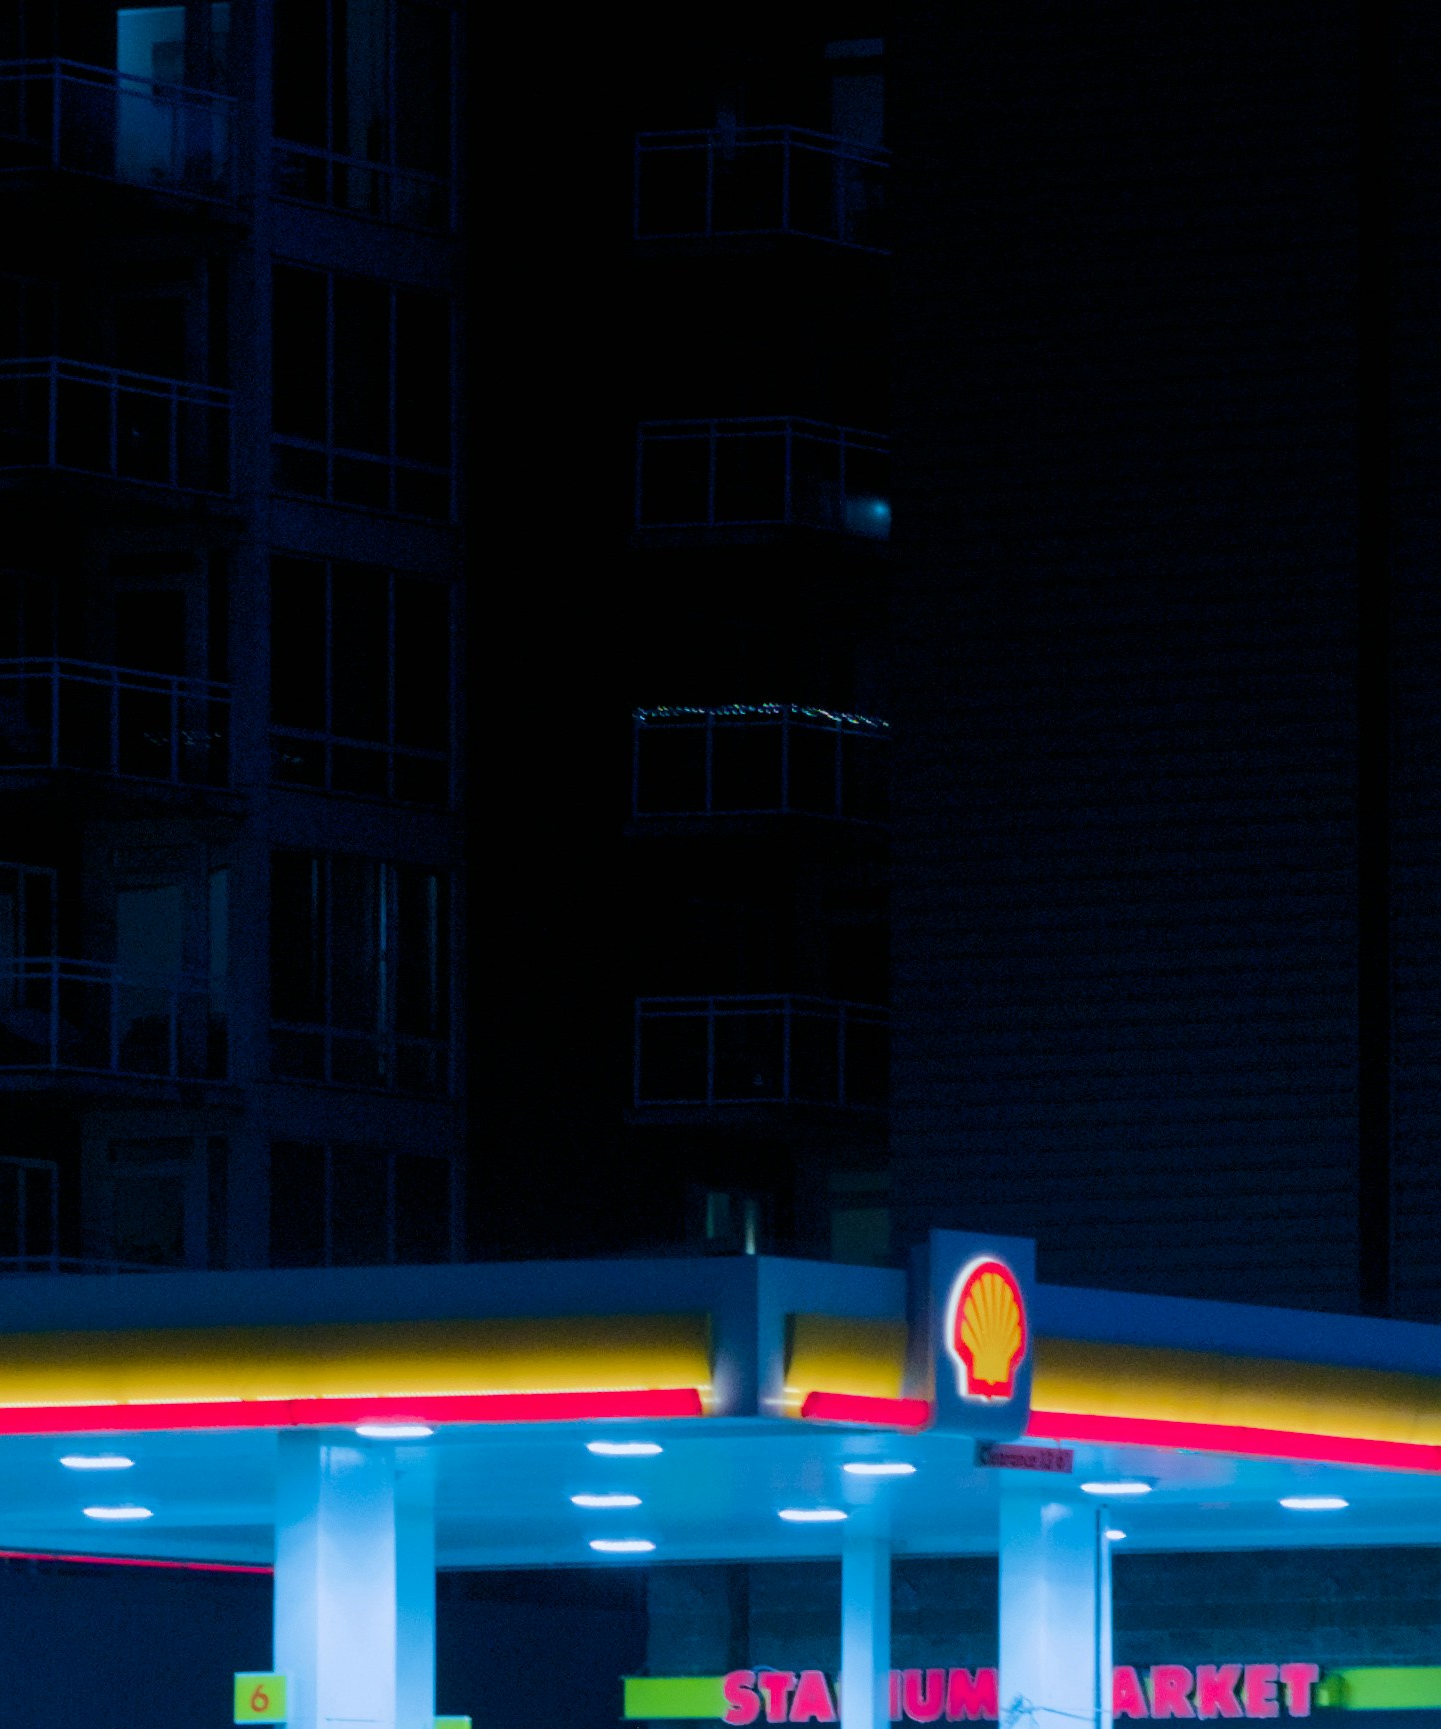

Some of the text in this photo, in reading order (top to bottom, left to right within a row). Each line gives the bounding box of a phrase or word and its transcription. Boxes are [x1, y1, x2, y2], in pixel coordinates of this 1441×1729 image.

[250, 1684, 269, 1713] 6
[722, 1662, 1319, 1726] STAIUM ARKET
